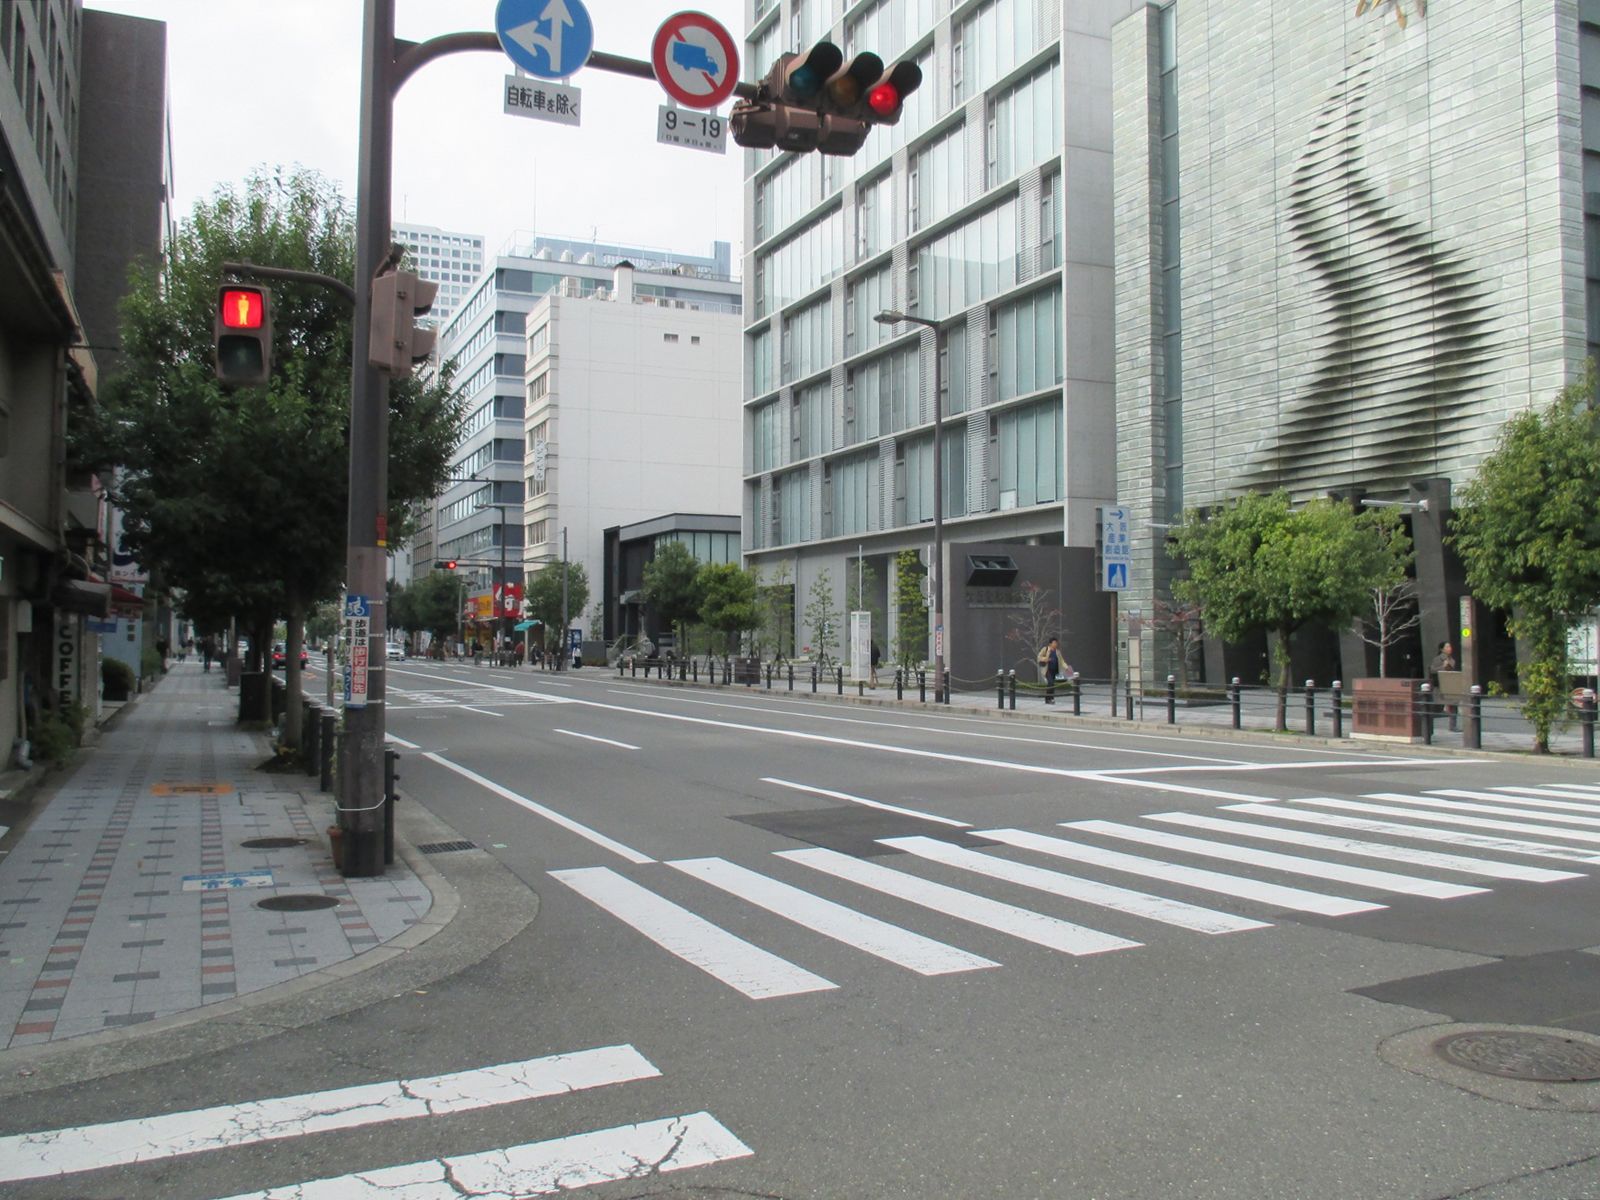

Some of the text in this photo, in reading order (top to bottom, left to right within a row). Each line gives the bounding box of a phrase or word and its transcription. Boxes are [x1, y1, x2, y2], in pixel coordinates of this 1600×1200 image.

[507, 85, 578, 117] 自転車を除く
